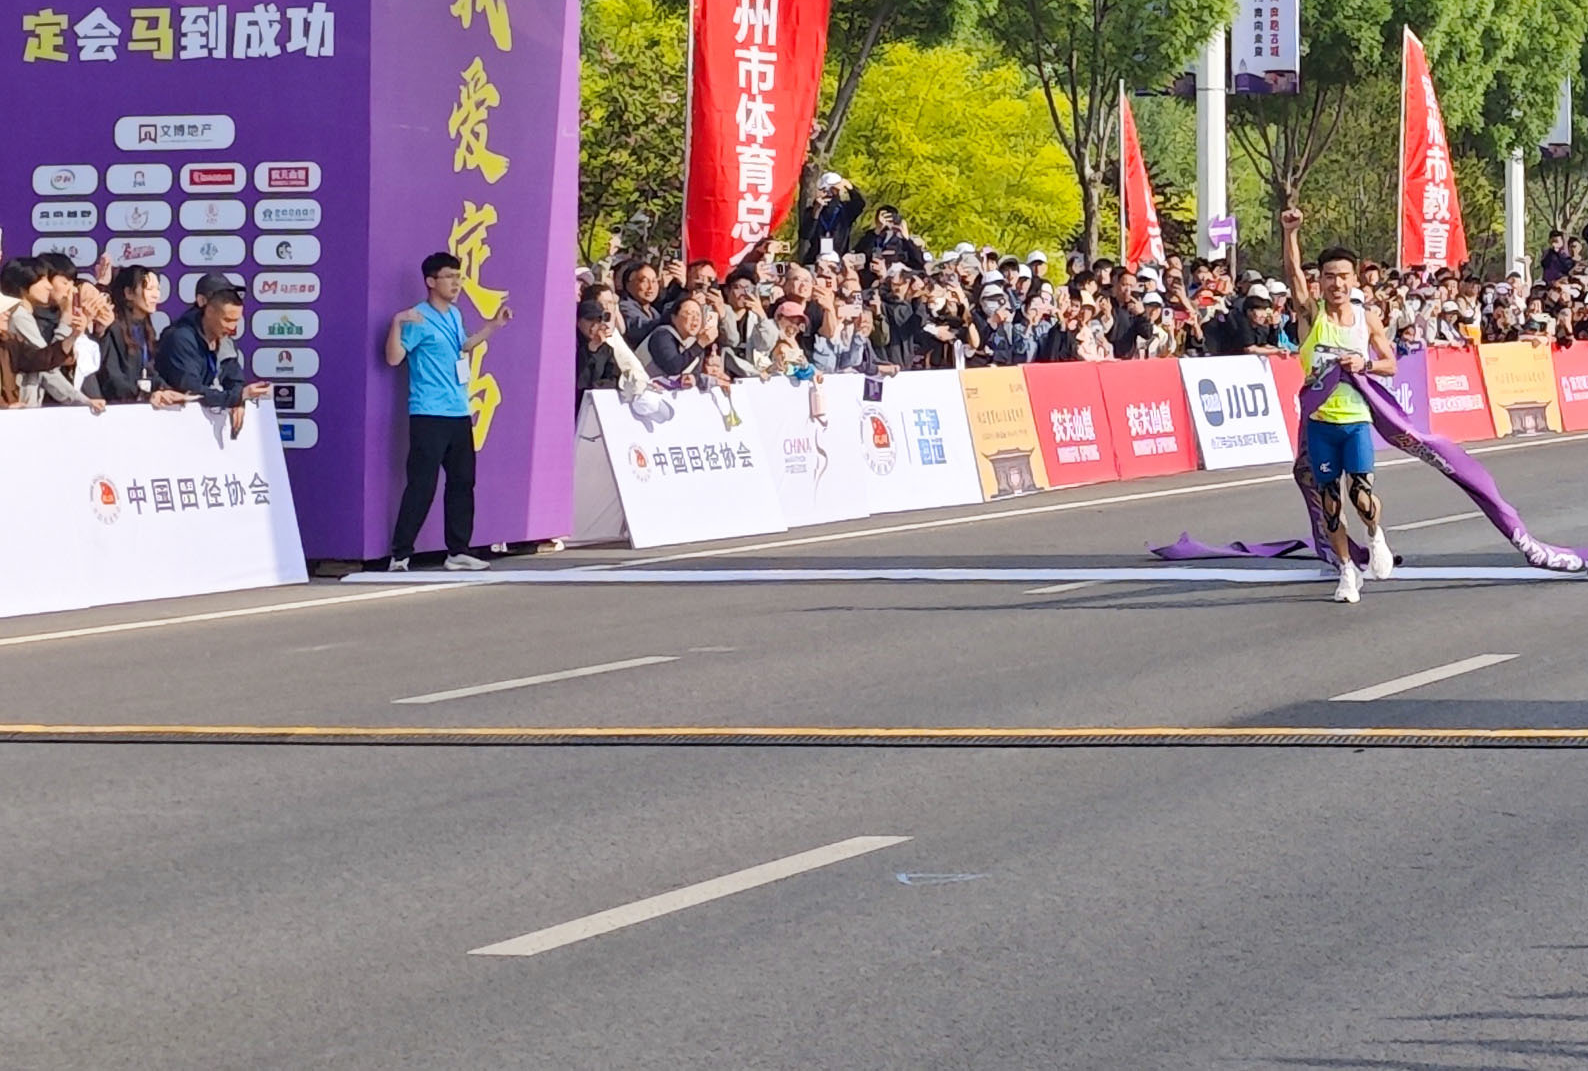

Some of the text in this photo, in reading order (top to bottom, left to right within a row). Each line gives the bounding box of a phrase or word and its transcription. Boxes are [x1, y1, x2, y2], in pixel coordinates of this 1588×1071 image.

[23, 2, 334, 62] 定会马到成功
[159, 123, 213, 137] 文博地产
[653, 442, 754, 475] 中国田径协会
[127, 472, 271, 514] 中国田径协会
